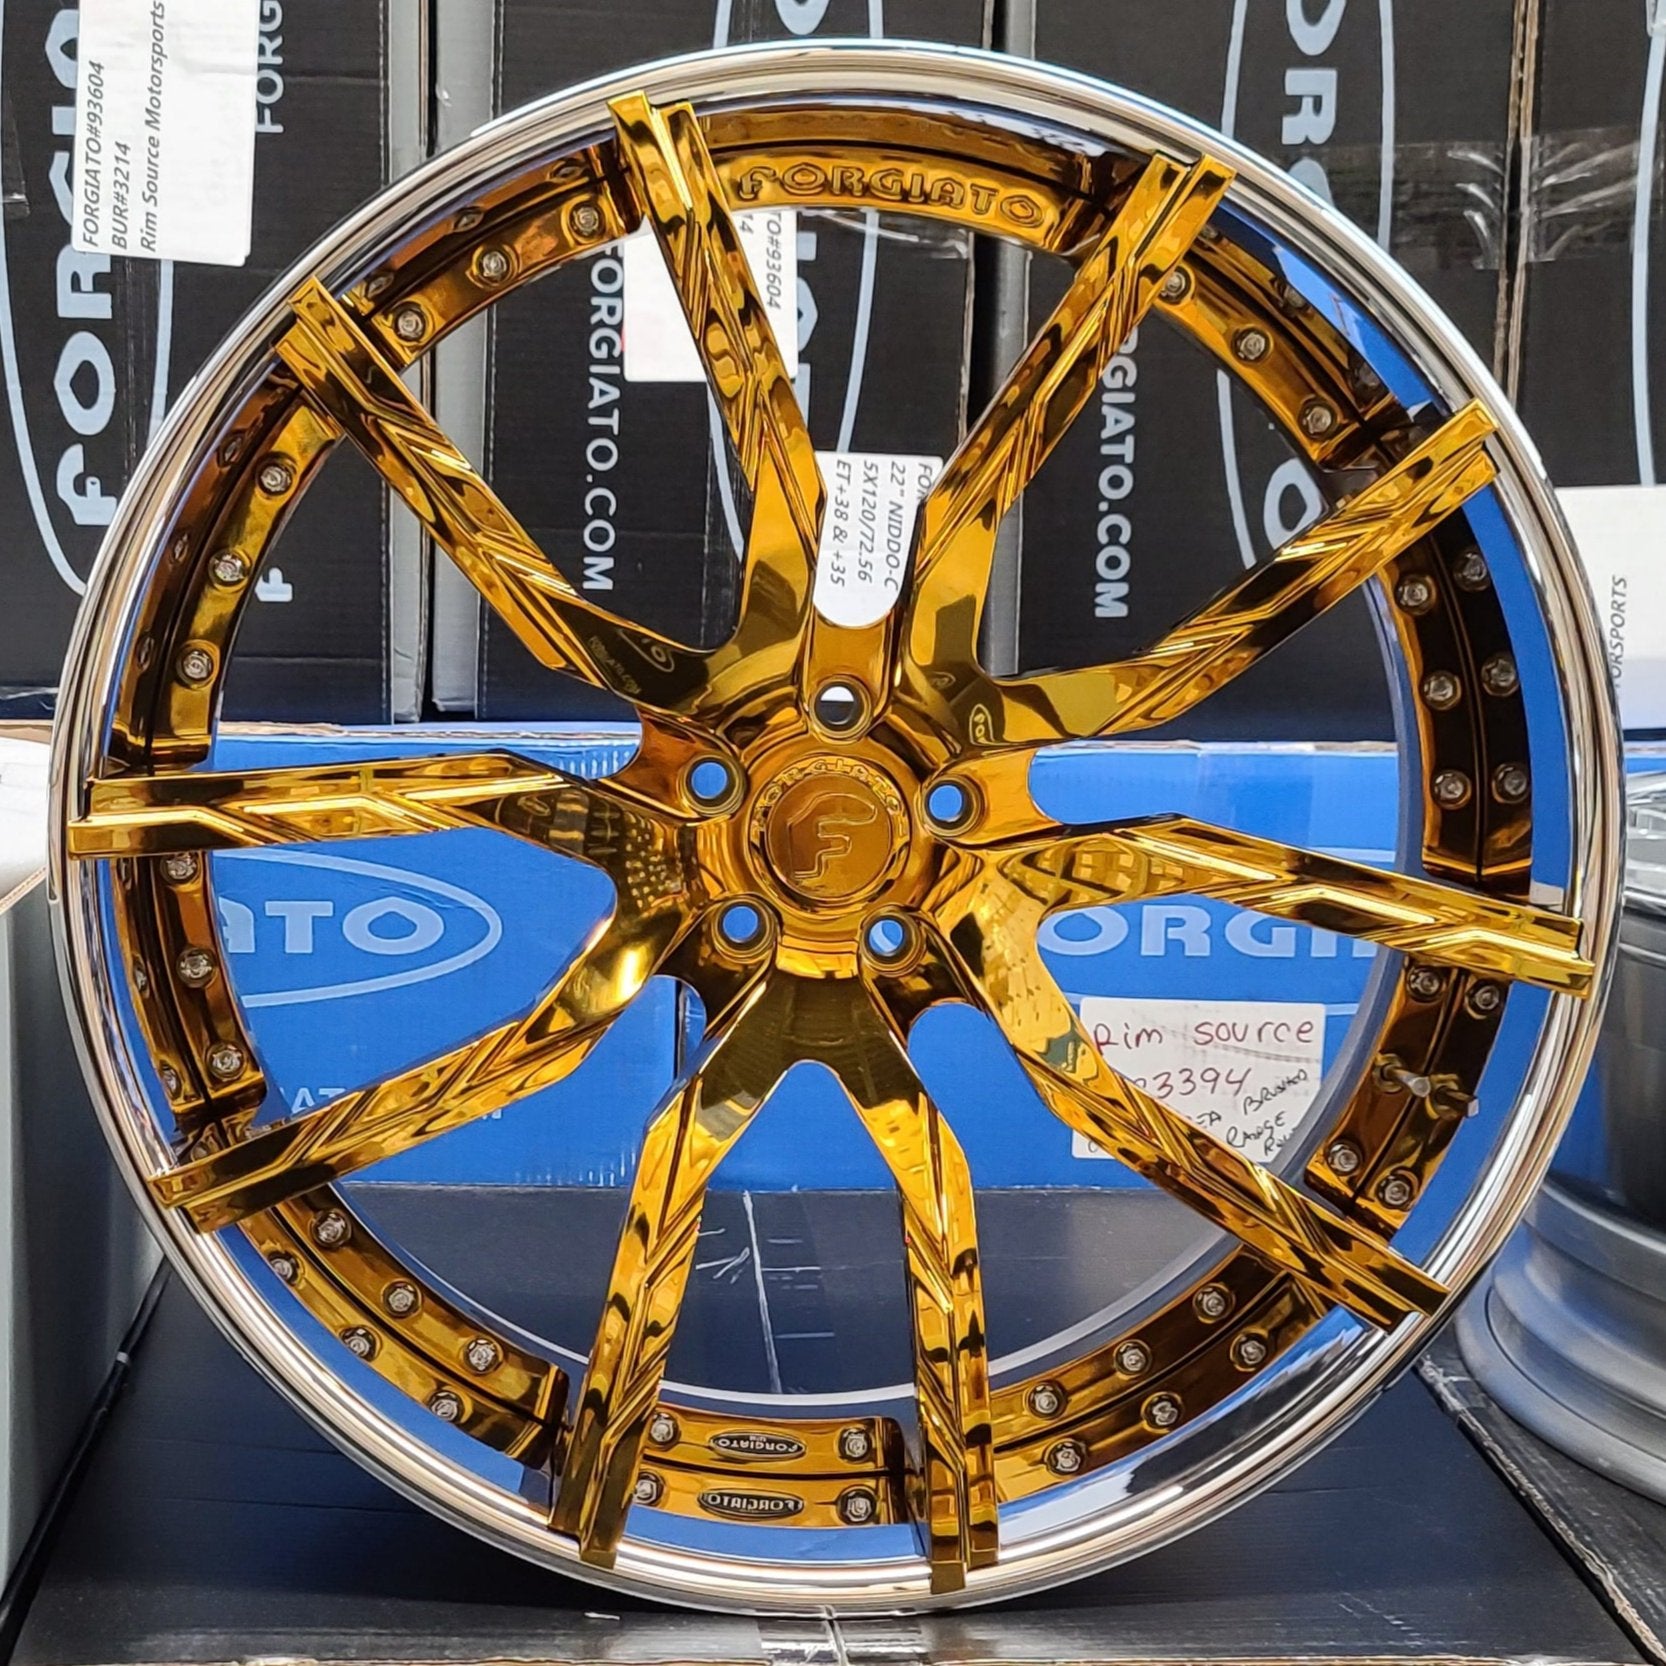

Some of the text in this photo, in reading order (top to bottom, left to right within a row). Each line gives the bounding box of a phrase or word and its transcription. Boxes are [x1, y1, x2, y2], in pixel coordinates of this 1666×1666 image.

[82, 59, 105, 248] FORGIATO#93604
[140, 2, 168, 252] Rim Source Motorsports
[110, 140, 131, 251] BUR#3214
[738, 162, 1045, 229] FORGIATO
[830, 551, 846, 587] +35
[832, 525, 848, 544] &
[1610, 574, 1628, 688] ORSPORTS
